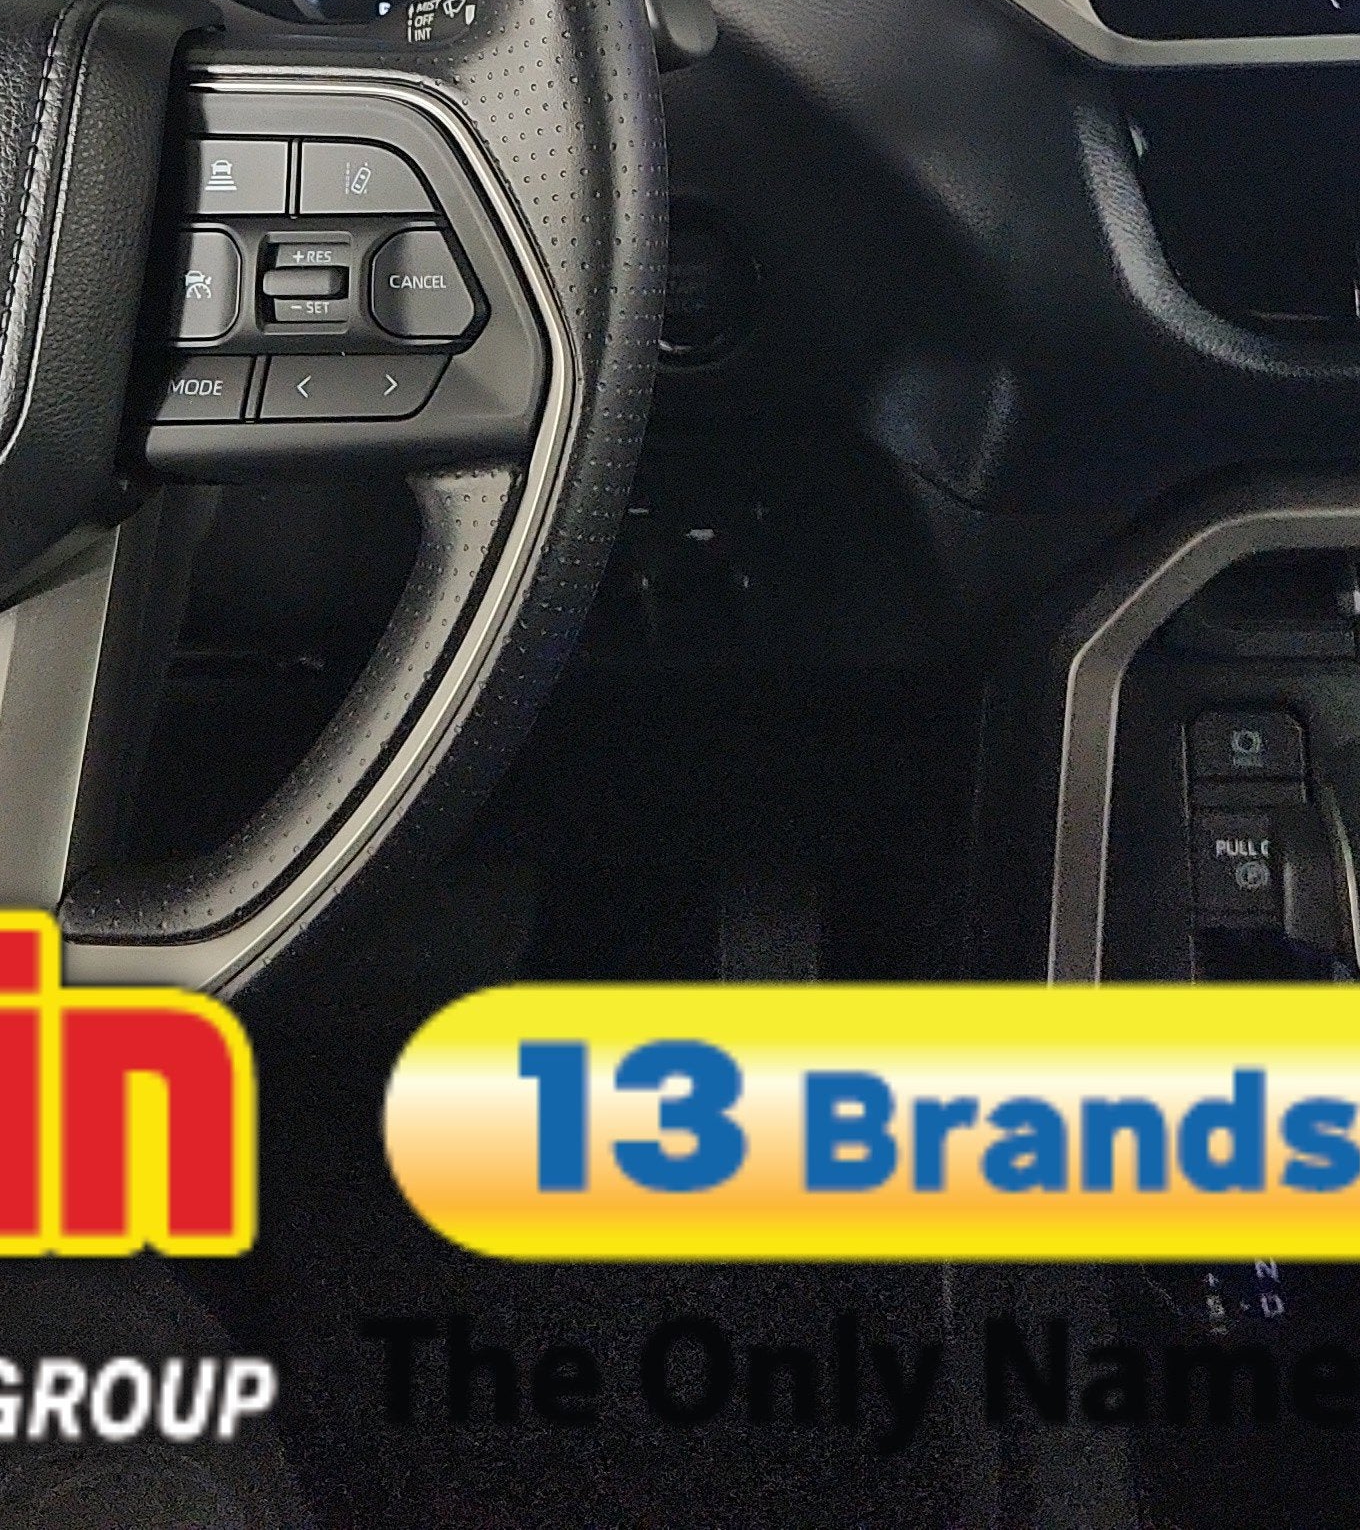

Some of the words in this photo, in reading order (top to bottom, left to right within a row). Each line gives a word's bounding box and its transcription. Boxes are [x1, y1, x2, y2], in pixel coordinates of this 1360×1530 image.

[413, 14, 435, 28] OFF
[414, 28, 433, 42] INT
[389, 274, 447, 290] CANCEL
[168, 378, 224, 396] MODE
[1215, 839, 1257, 858] PULL
